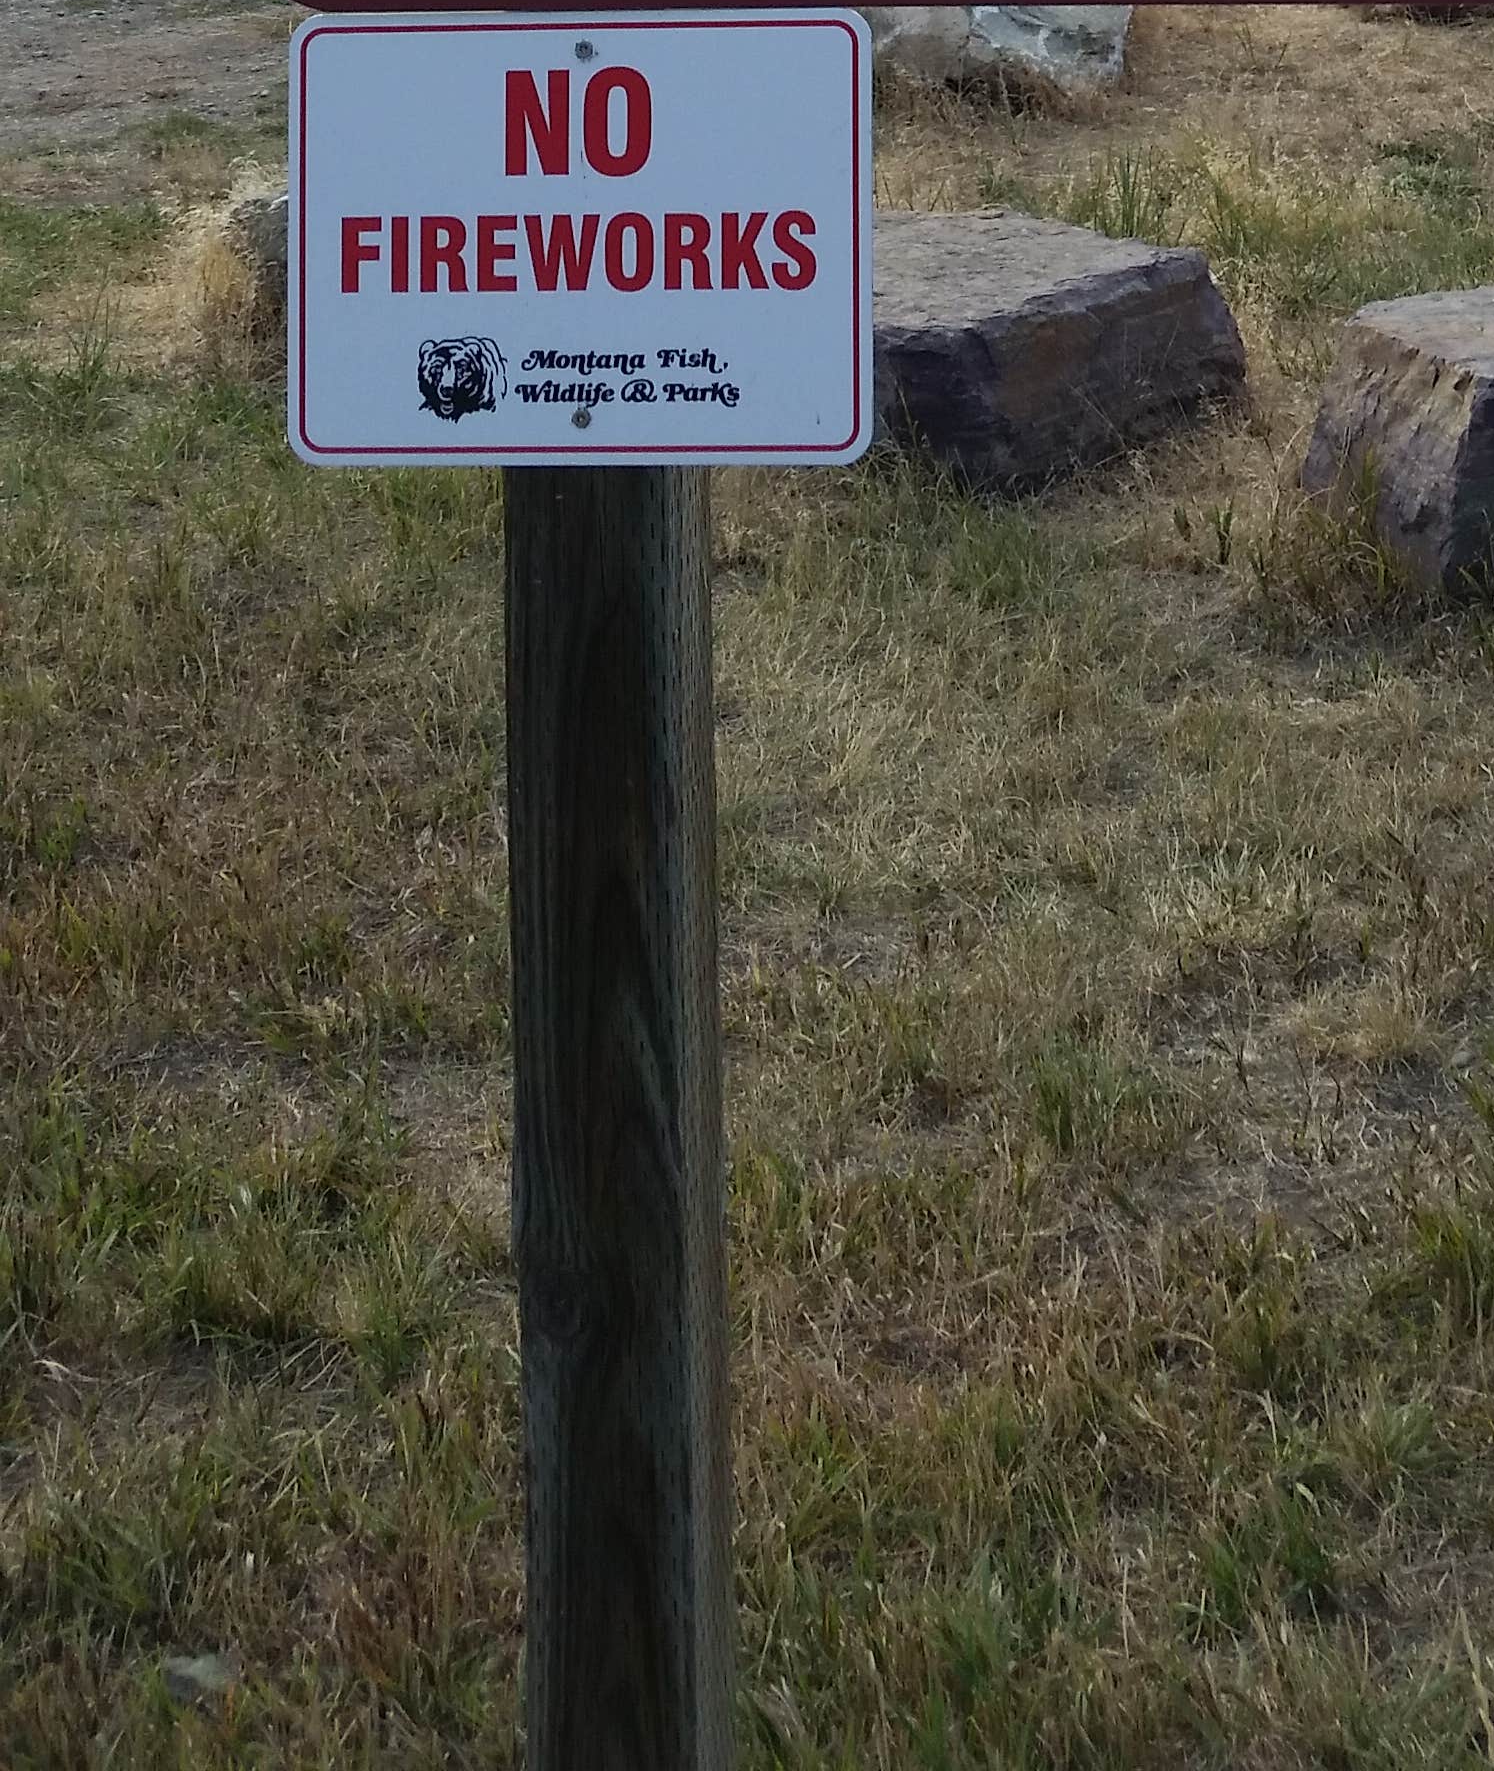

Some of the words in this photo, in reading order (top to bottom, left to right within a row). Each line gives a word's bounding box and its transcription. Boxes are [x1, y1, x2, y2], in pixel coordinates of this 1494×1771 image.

[504, 66, 653, 179] NO
[342, 211, 816, 293] FIREWORKS
[521, 350, 645, 375] Montana
[657, 348, 729, 374] Fish,
[515, 380, 615, 408] Wildlife
[621, 378, 658, 403] &
[662, 381, 741, 408] Parks
